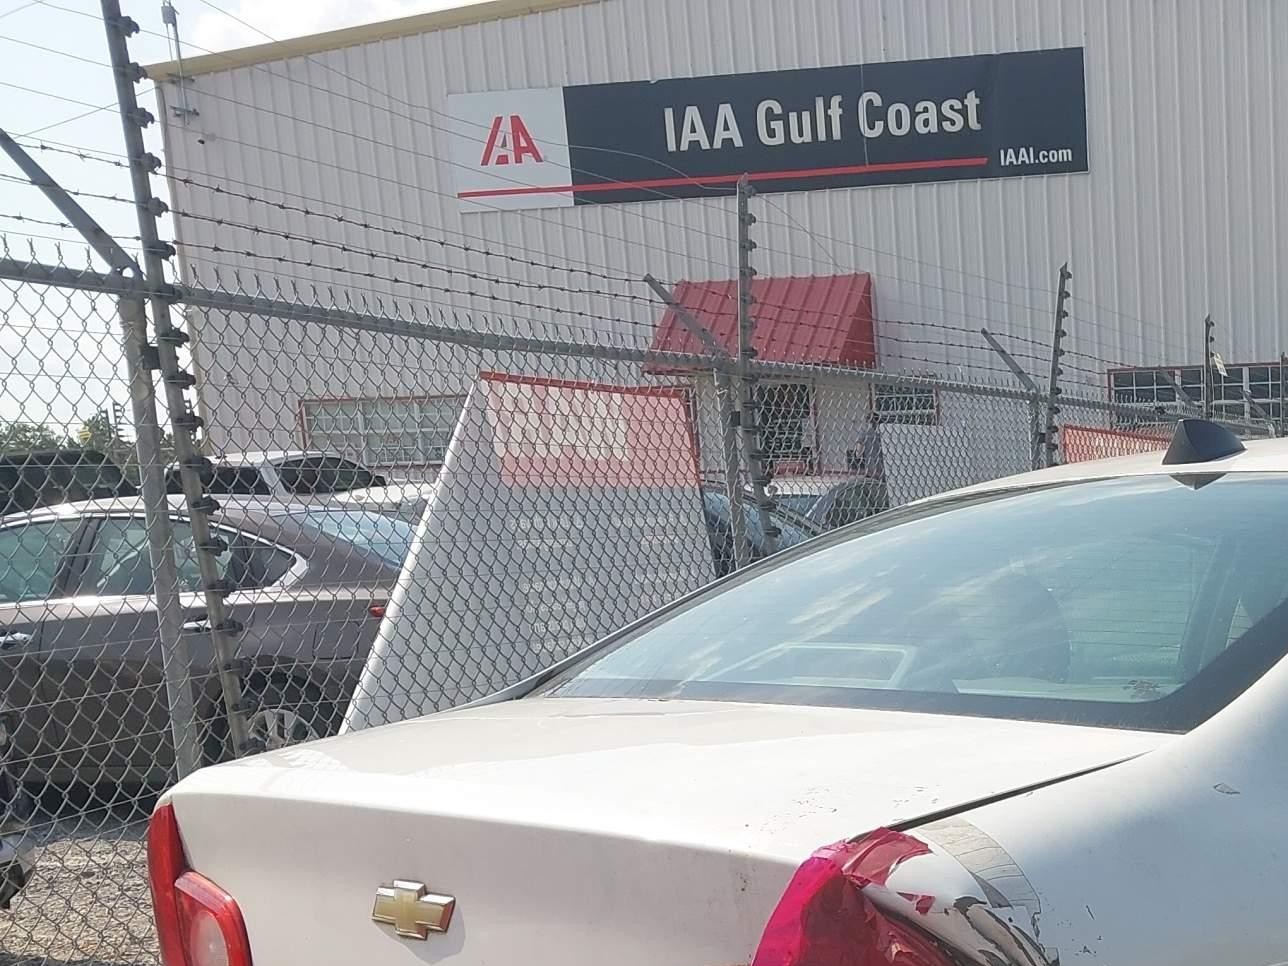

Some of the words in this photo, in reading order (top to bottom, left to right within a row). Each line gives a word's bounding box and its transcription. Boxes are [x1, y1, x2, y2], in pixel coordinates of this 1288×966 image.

[664, 103, 744, 152] IAA
[756, 95, 843, 146] Gulf
[857, 90, 982, 138] Coast
[1000, 146, 1073, 166] IAAI.com
